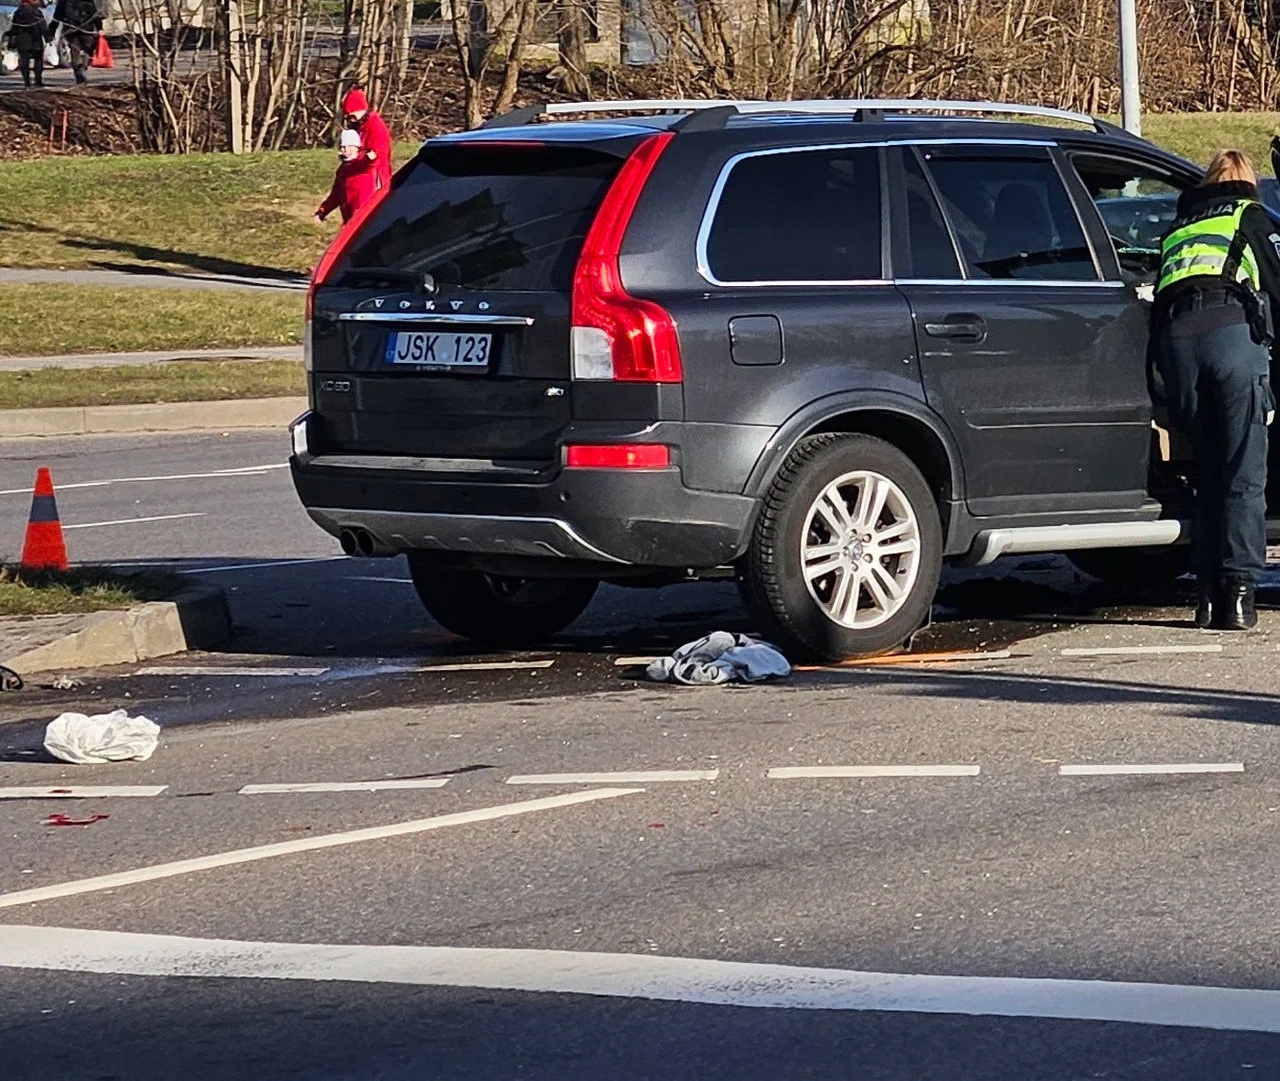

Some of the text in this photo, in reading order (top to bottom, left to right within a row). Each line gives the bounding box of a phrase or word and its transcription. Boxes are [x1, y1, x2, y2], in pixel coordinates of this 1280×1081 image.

[373, 298, 490, 312] VOLVO
[397, 334, 489, 363] JSK 123
